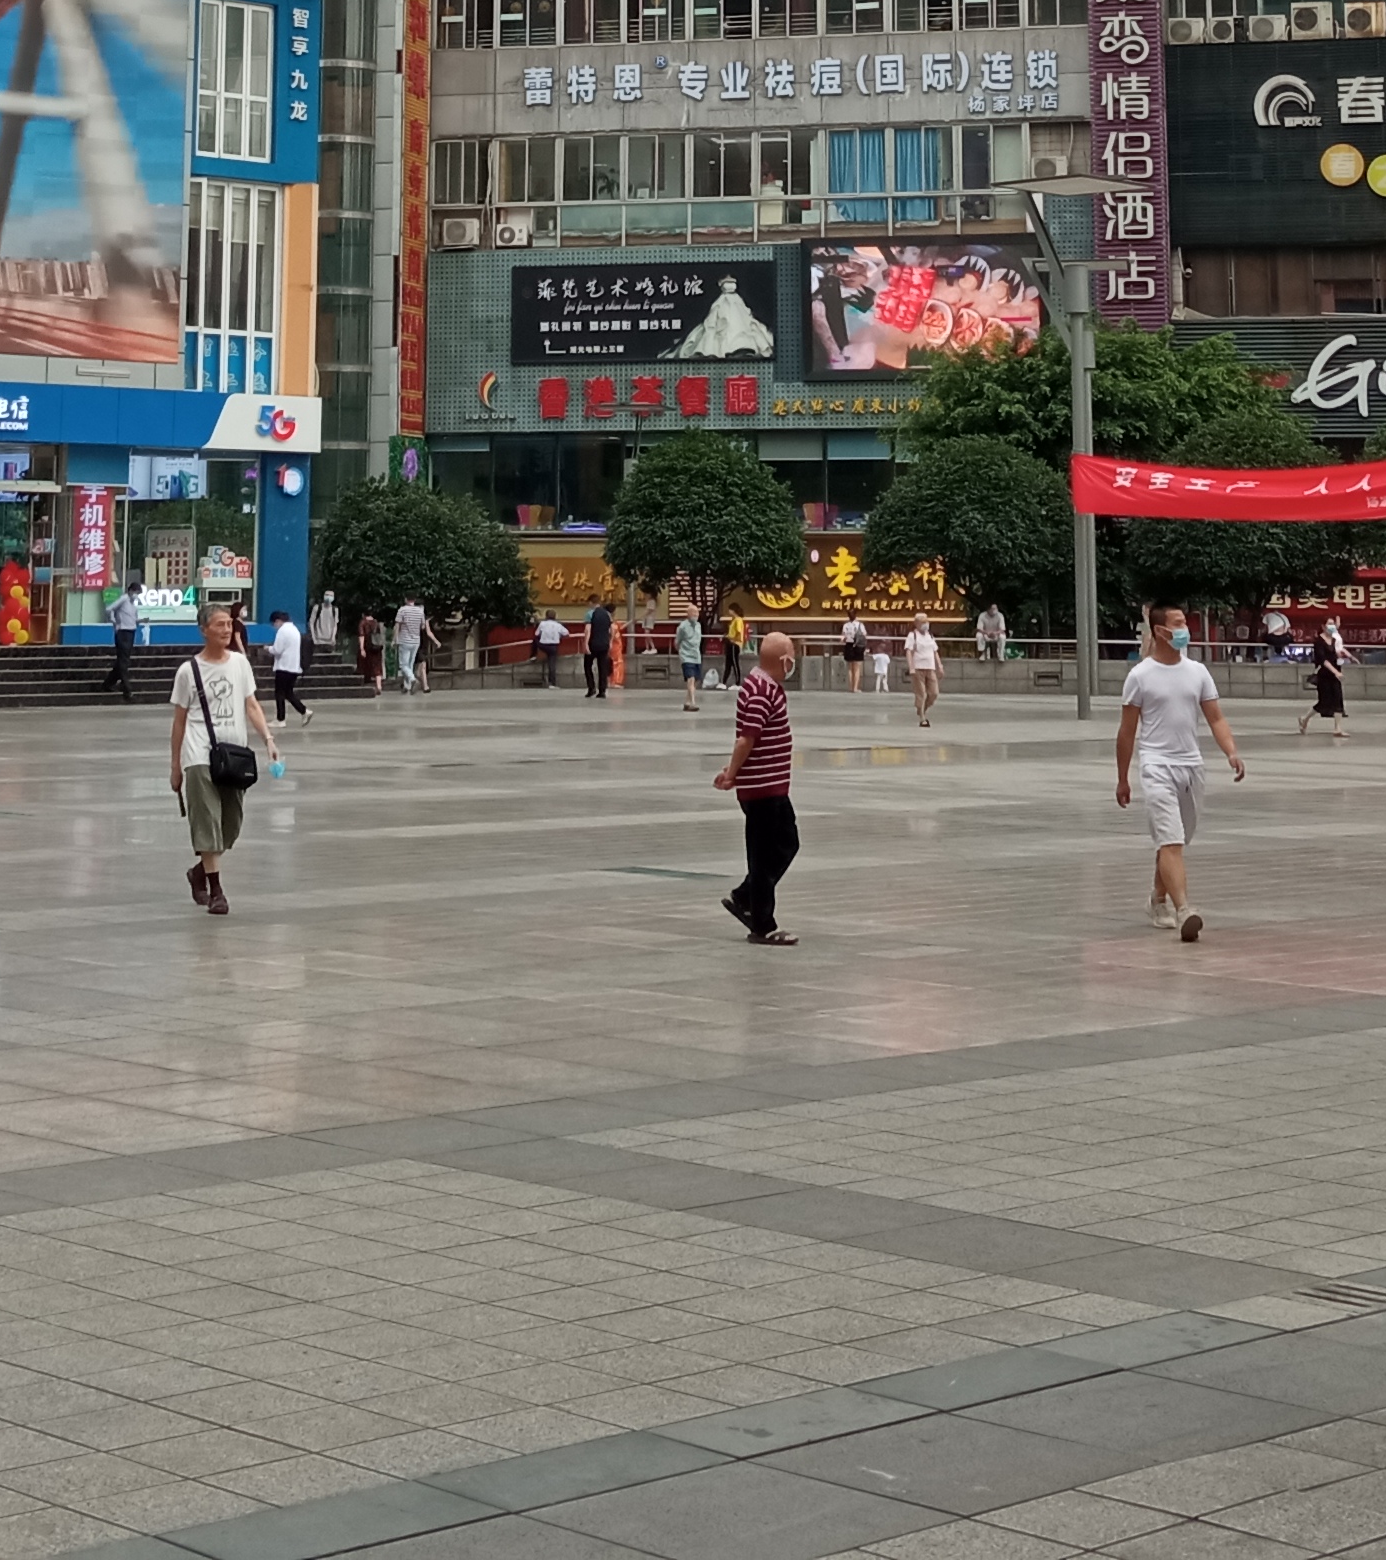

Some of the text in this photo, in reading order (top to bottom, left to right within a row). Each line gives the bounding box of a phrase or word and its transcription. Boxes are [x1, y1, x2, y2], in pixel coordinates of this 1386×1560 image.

[290, 8, 310, 122] 智享九龙
[968, 94, 1059, 114] 杨家坪店
[256, 405, 296, 441] 5G
[1112, 466, 1261, 493] 安全生产
[78, 485, 108, 575] 手机维修
[212, 547, 235, 567] 5G
[134, 584, 195, 607] Reno4
